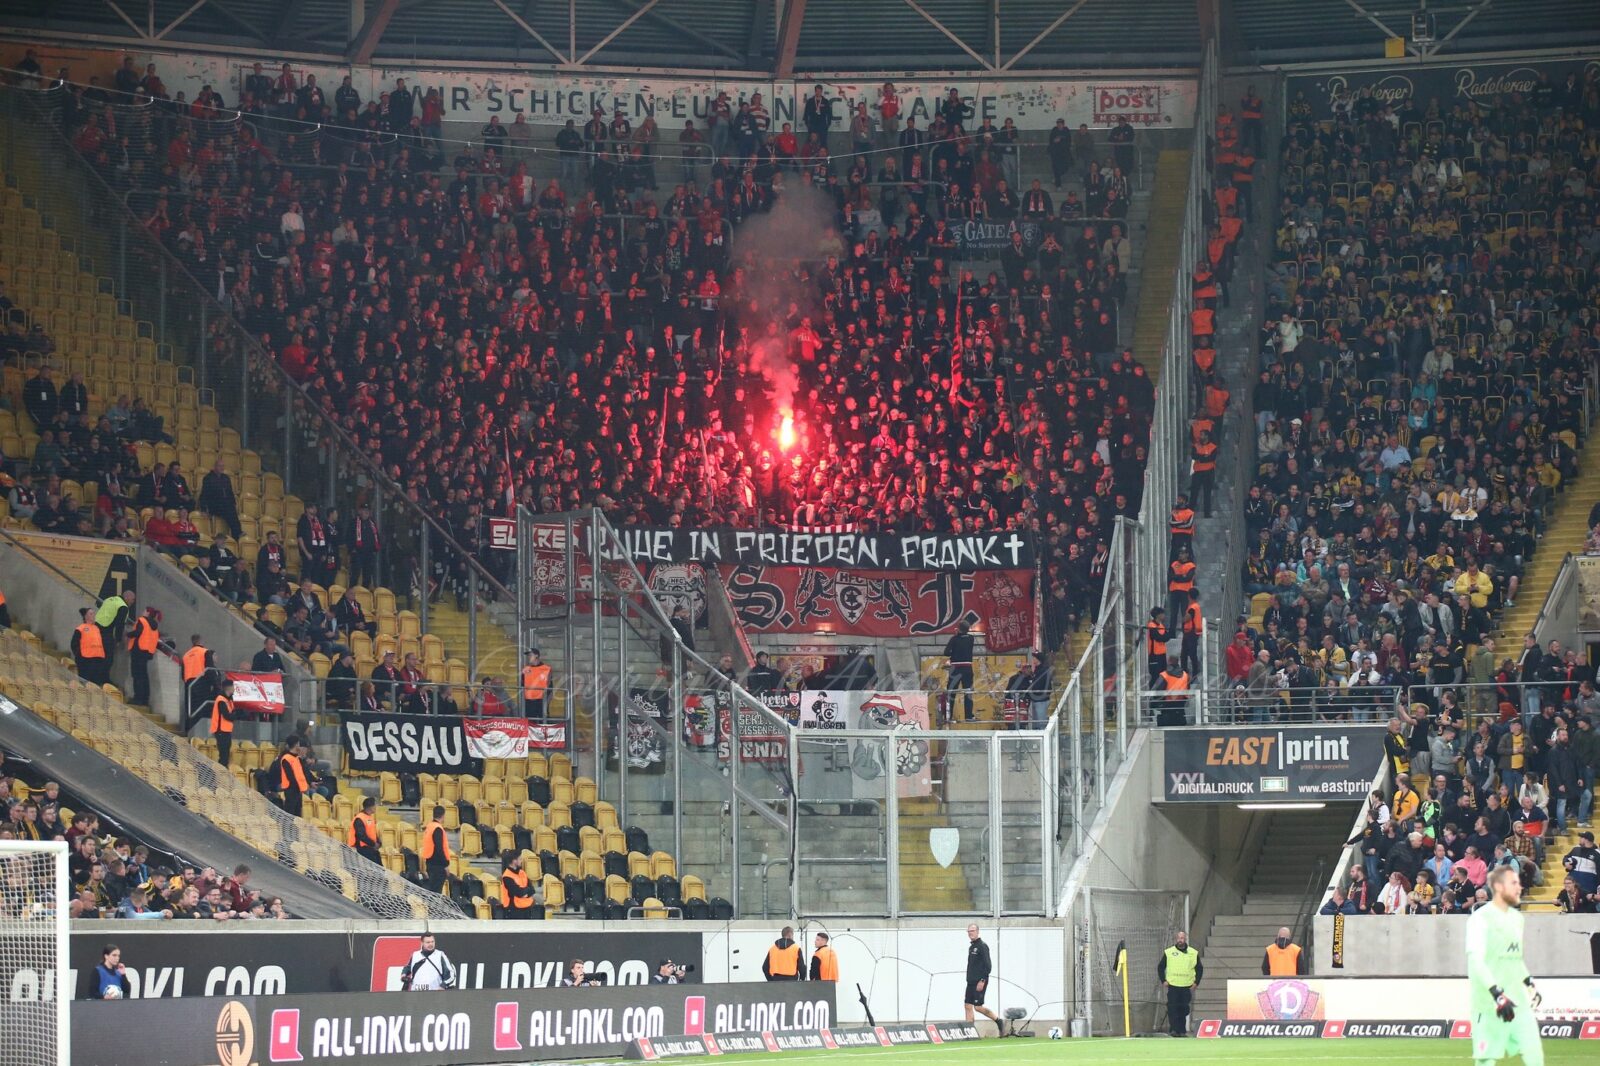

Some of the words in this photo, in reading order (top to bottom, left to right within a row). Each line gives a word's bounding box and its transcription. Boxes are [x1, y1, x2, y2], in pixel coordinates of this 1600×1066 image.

[487, 88, 654, 117] SCHICKEN
[587, 525, 673, 562] RUHE
[689, 531, 721, 561] IN
[902, 535, 1001, 569] FRANK
[346, 721, 463, 765] DESSAU
[1206, 737, 1275, 765] EAST
[1286, 735, 1350, 765] print
[1178, 782, 1254, 794] DIGITALDRUCK
[530, 1006, 664, 1047] ALL-INKL.COM
[714, 1000, 830, 1034] ALL-INKL.COM
[1223, 1024, 1316, 1036] ALL-INKL.COM
[1348, 1024, 1442, 1036] ALL-INKL.COM
[313, 1012, 471, 1058] ALL-INKL.COM
